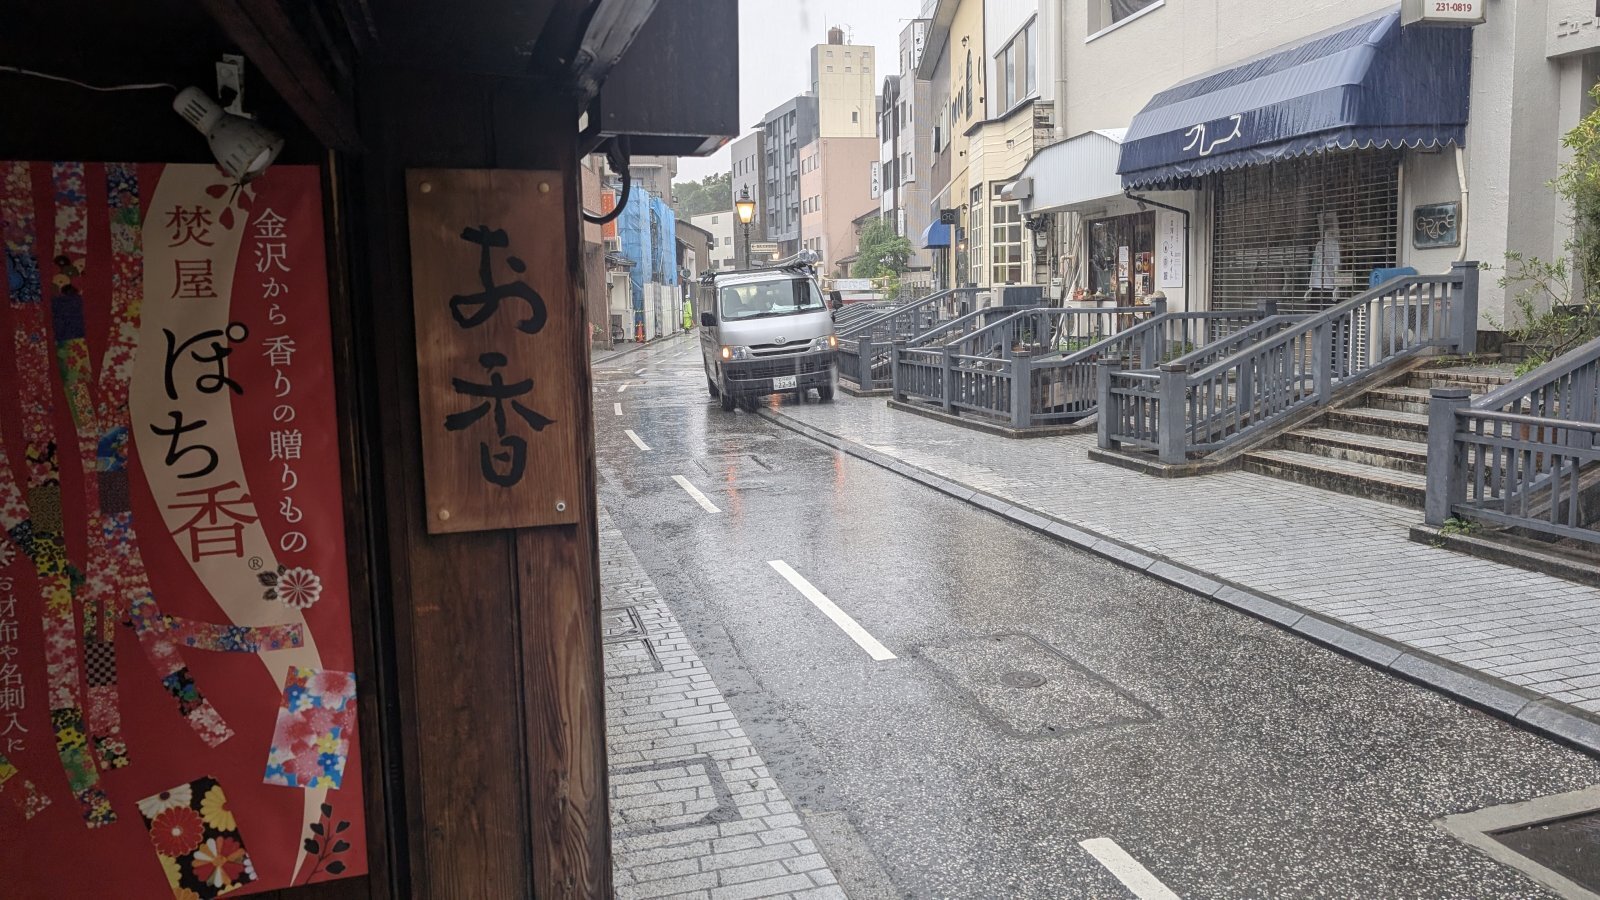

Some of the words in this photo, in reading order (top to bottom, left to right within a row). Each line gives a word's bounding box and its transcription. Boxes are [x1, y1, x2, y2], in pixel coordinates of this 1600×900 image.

[1435, 3, 1472, 12] 231-0819
[164, 204, 218, 299] 焚屋
[444, 224, 558, 488] お香
